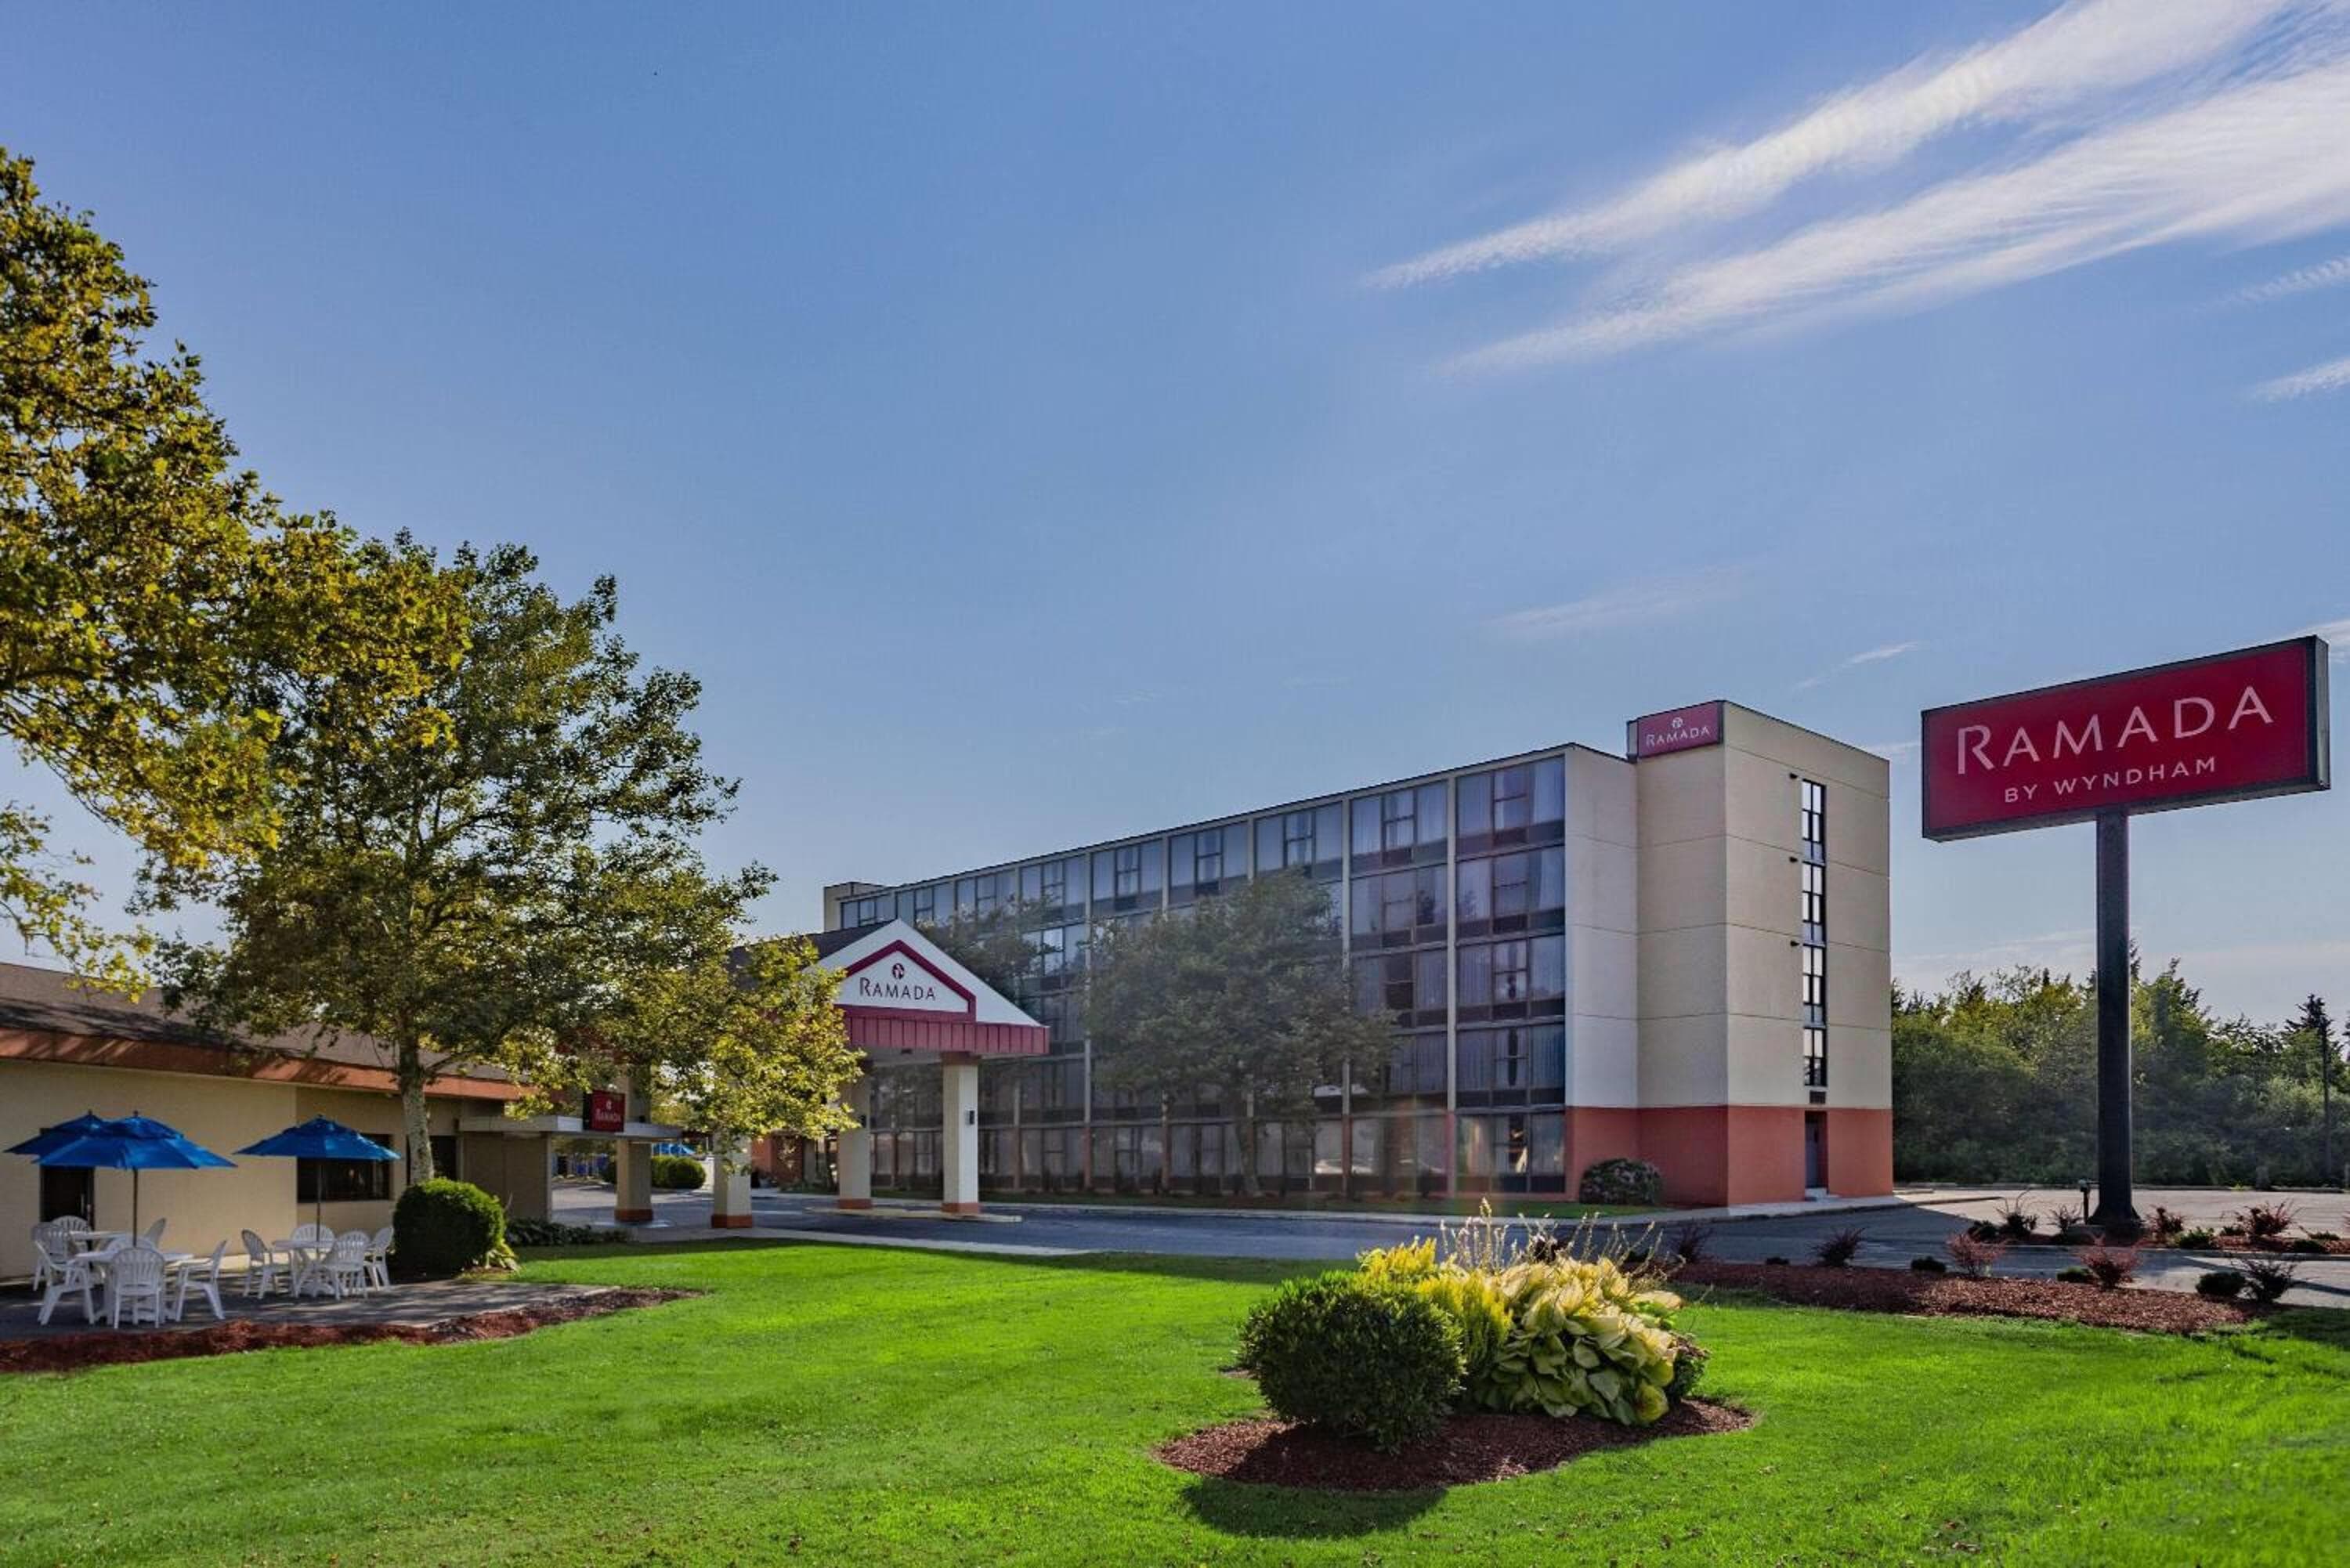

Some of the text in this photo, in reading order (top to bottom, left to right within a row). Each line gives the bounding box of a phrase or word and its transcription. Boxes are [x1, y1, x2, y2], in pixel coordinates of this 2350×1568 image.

[1646, 726, 1709, 747] RAMADA
[1958, 686, 2273, 775] RAMADA
[2005, 757, 2216, 803] BY WYNDHAM
[859, 977, 935, 1000] RAMADA
